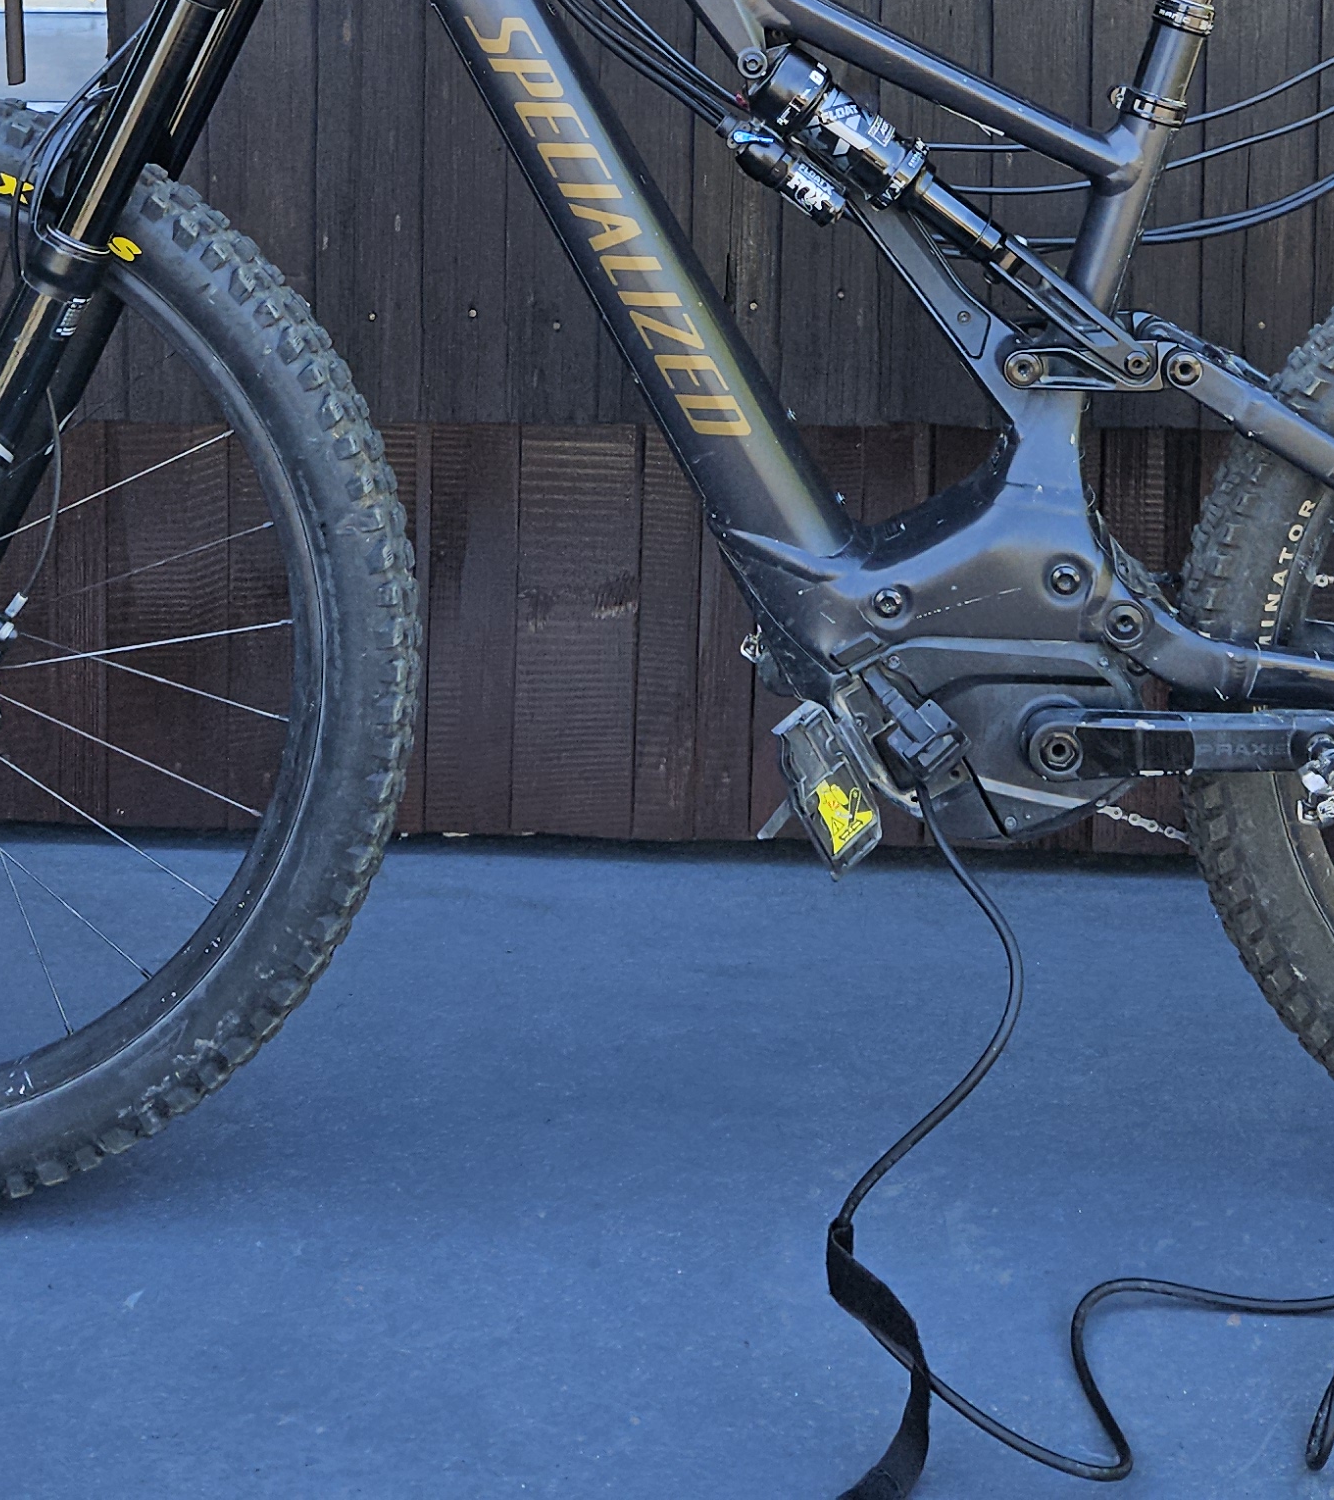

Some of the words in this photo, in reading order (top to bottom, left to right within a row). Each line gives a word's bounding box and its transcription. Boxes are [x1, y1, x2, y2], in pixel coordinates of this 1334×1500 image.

[819, 104, 859, 124] FLOAT
[787, 172, 831, 211] FOX
[464, 15, 752, 437] SPECIALIZED
[1194, 742, 1288, 757] PRAXIS
